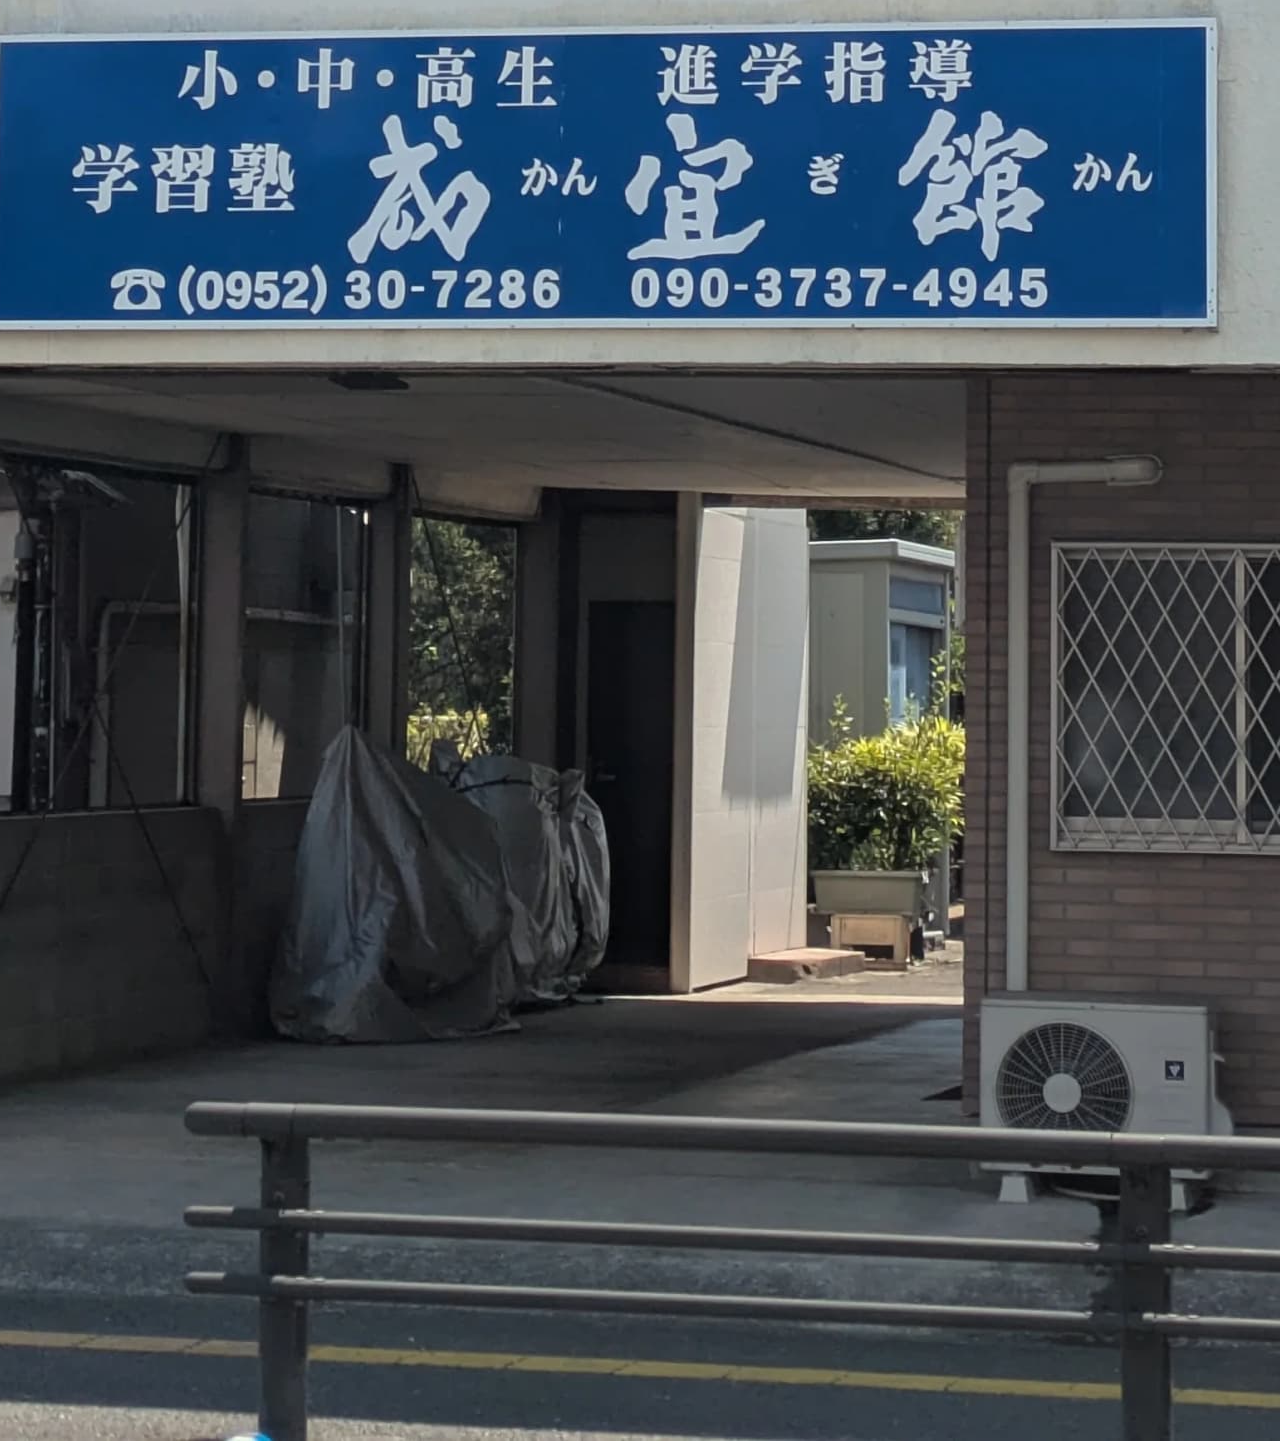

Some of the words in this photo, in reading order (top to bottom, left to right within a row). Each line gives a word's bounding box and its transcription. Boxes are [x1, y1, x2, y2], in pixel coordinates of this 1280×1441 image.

[656, 39, 974, 106] 進学指導
[71, 142, 295, 214] 学習塾
[631, 267, 1049, 308] 090-3737-4945
